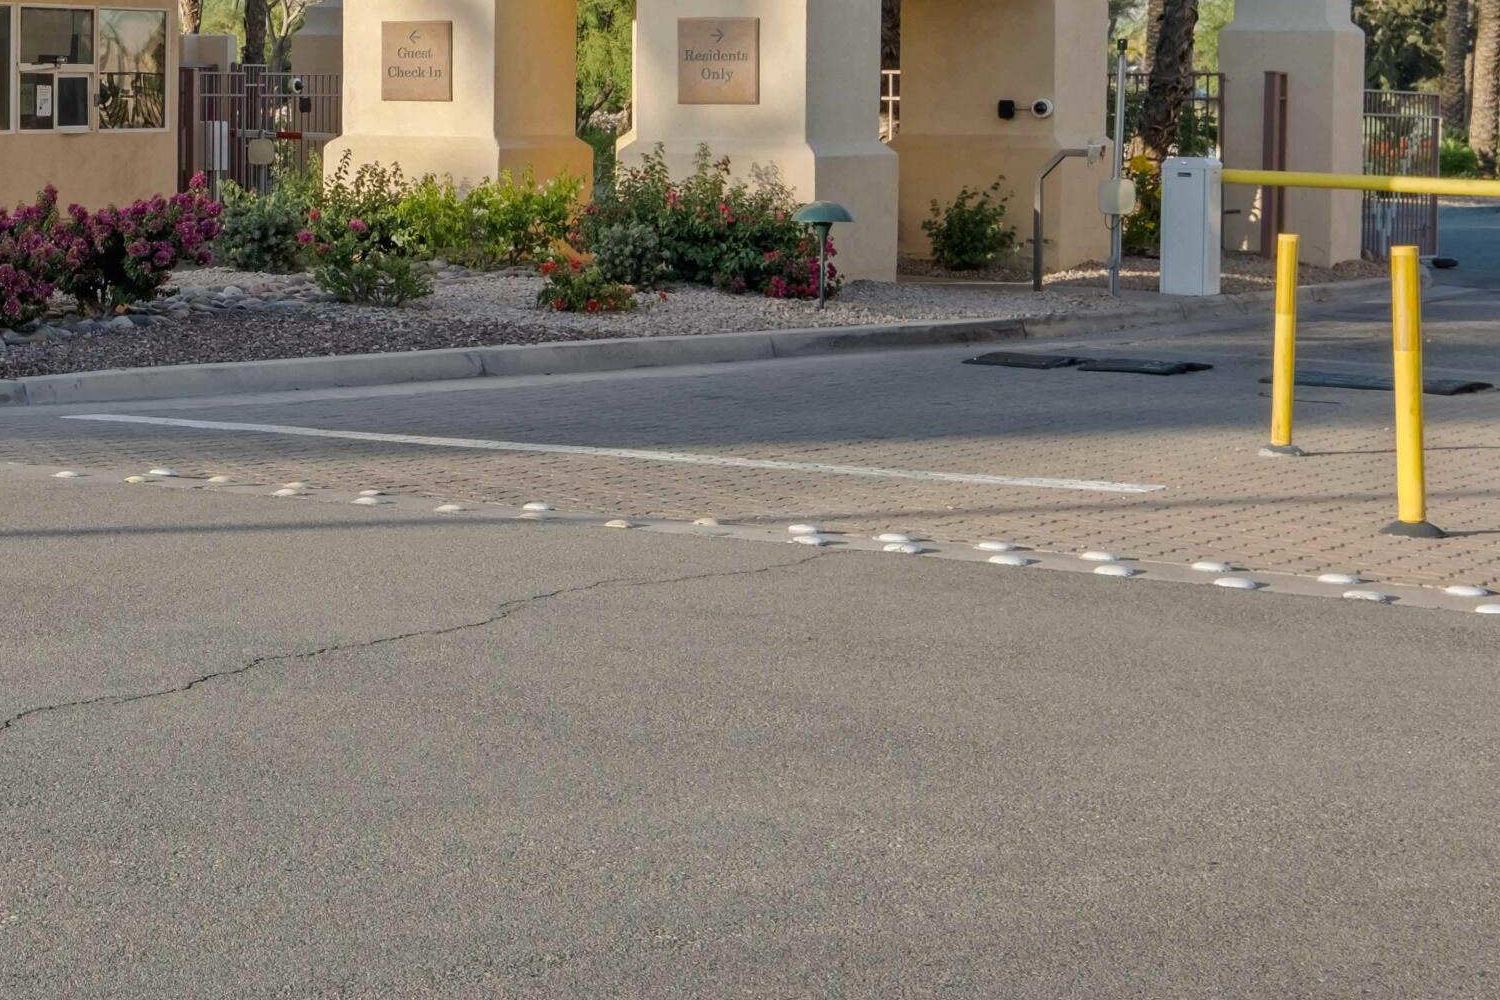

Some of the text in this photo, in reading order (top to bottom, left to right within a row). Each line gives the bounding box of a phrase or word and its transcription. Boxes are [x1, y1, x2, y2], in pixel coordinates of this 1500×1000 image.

[397, 47, 432, 58] Guest
[684, 48, 748, 61] Residents
[701, 67, 734, 82] Only
